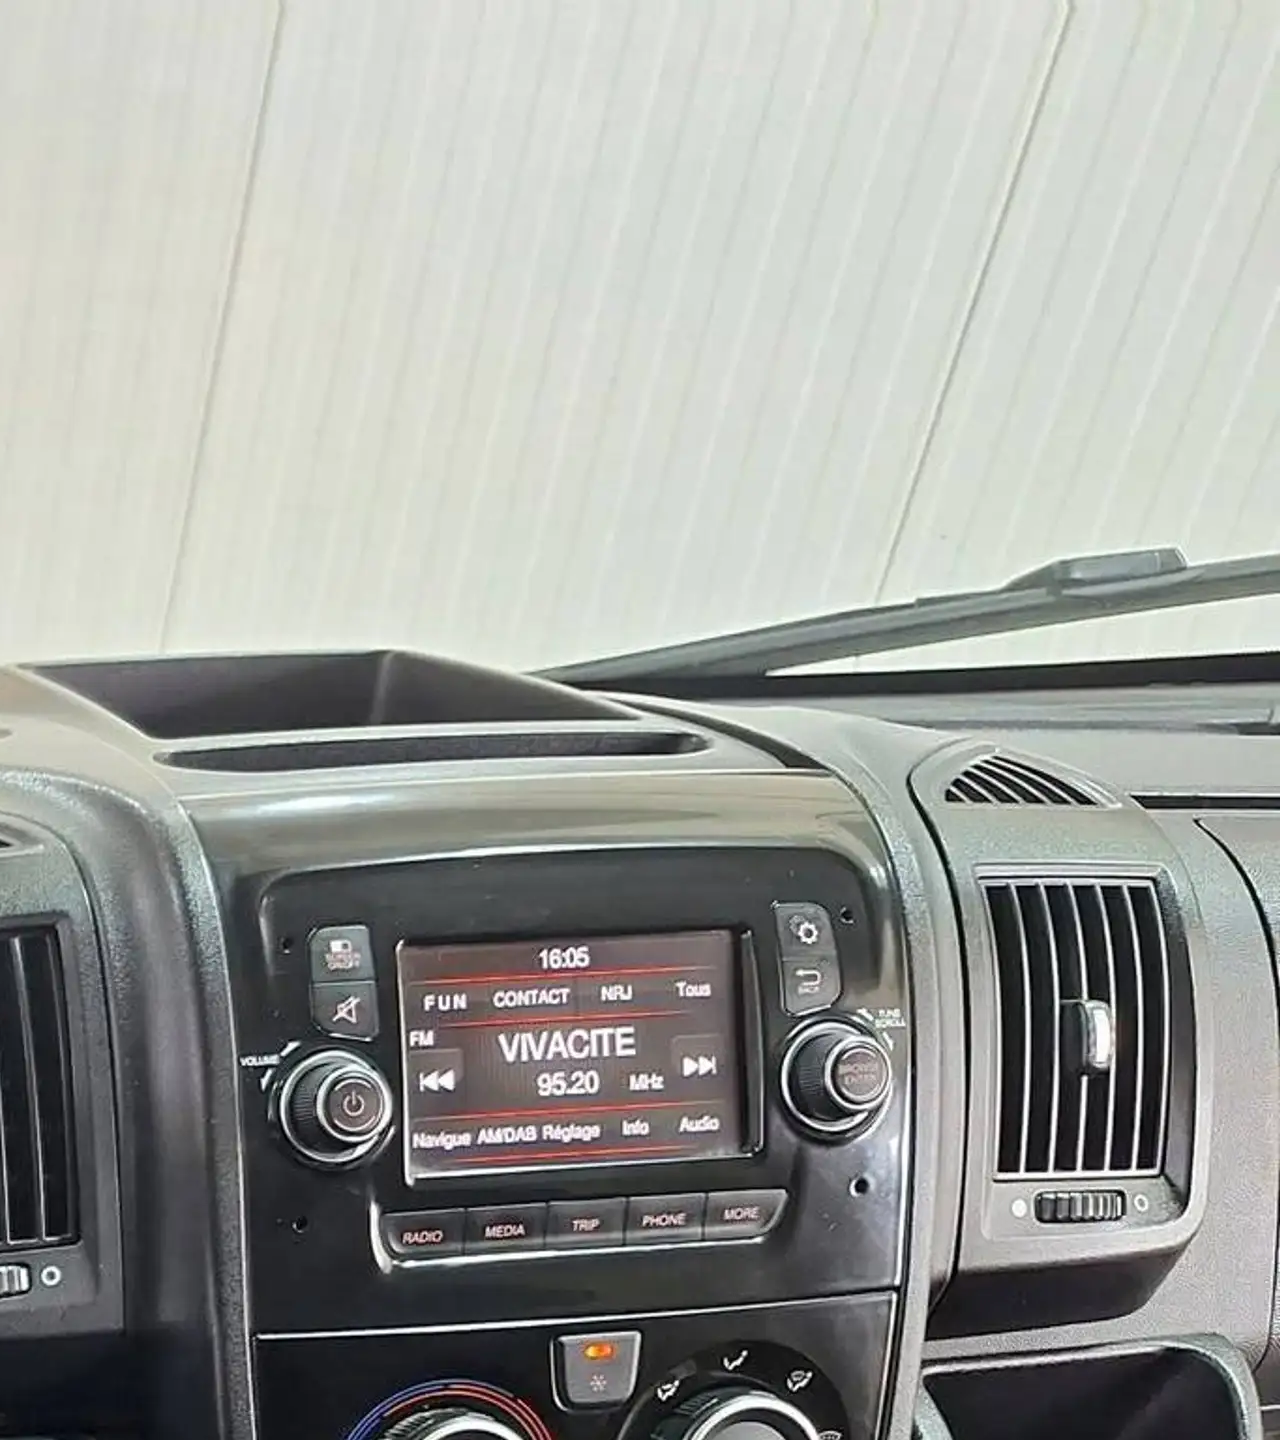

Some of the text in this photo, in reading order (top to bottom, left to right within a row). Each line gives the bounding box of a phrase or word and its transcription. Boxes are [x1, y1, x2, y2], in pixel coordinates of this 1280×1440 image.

[538, 946, 590, 969] 16:05
[492, 988, 571, 1008] CONTACT
[600, 984, 634, 1002] NRJ
[675, 980, 712, 998] Tous
[409, 1030, 435, 1048] FM
[498, 1026, 637, 1063] VIVACITE
[536, 1070, 664, 1096] 95.20 MHz
[542, 1122, 601, 1143] Réglage
[621, 1119, 650, 1137] Info
[679, 1115, 720, 1134] Audio
[412, 1130, 472, 1151] Navigue
[477, 1125, 538, 1145] AM/DAB
[642, 1211, 688, 1227] PHONE
[723, 1206, 761, 1221] MORE
[484, 1223, 526, 1240] MEDIA
[571, 1217, 600, 1232] TRIP
[402, 1229, 444, 1245] RADIO
